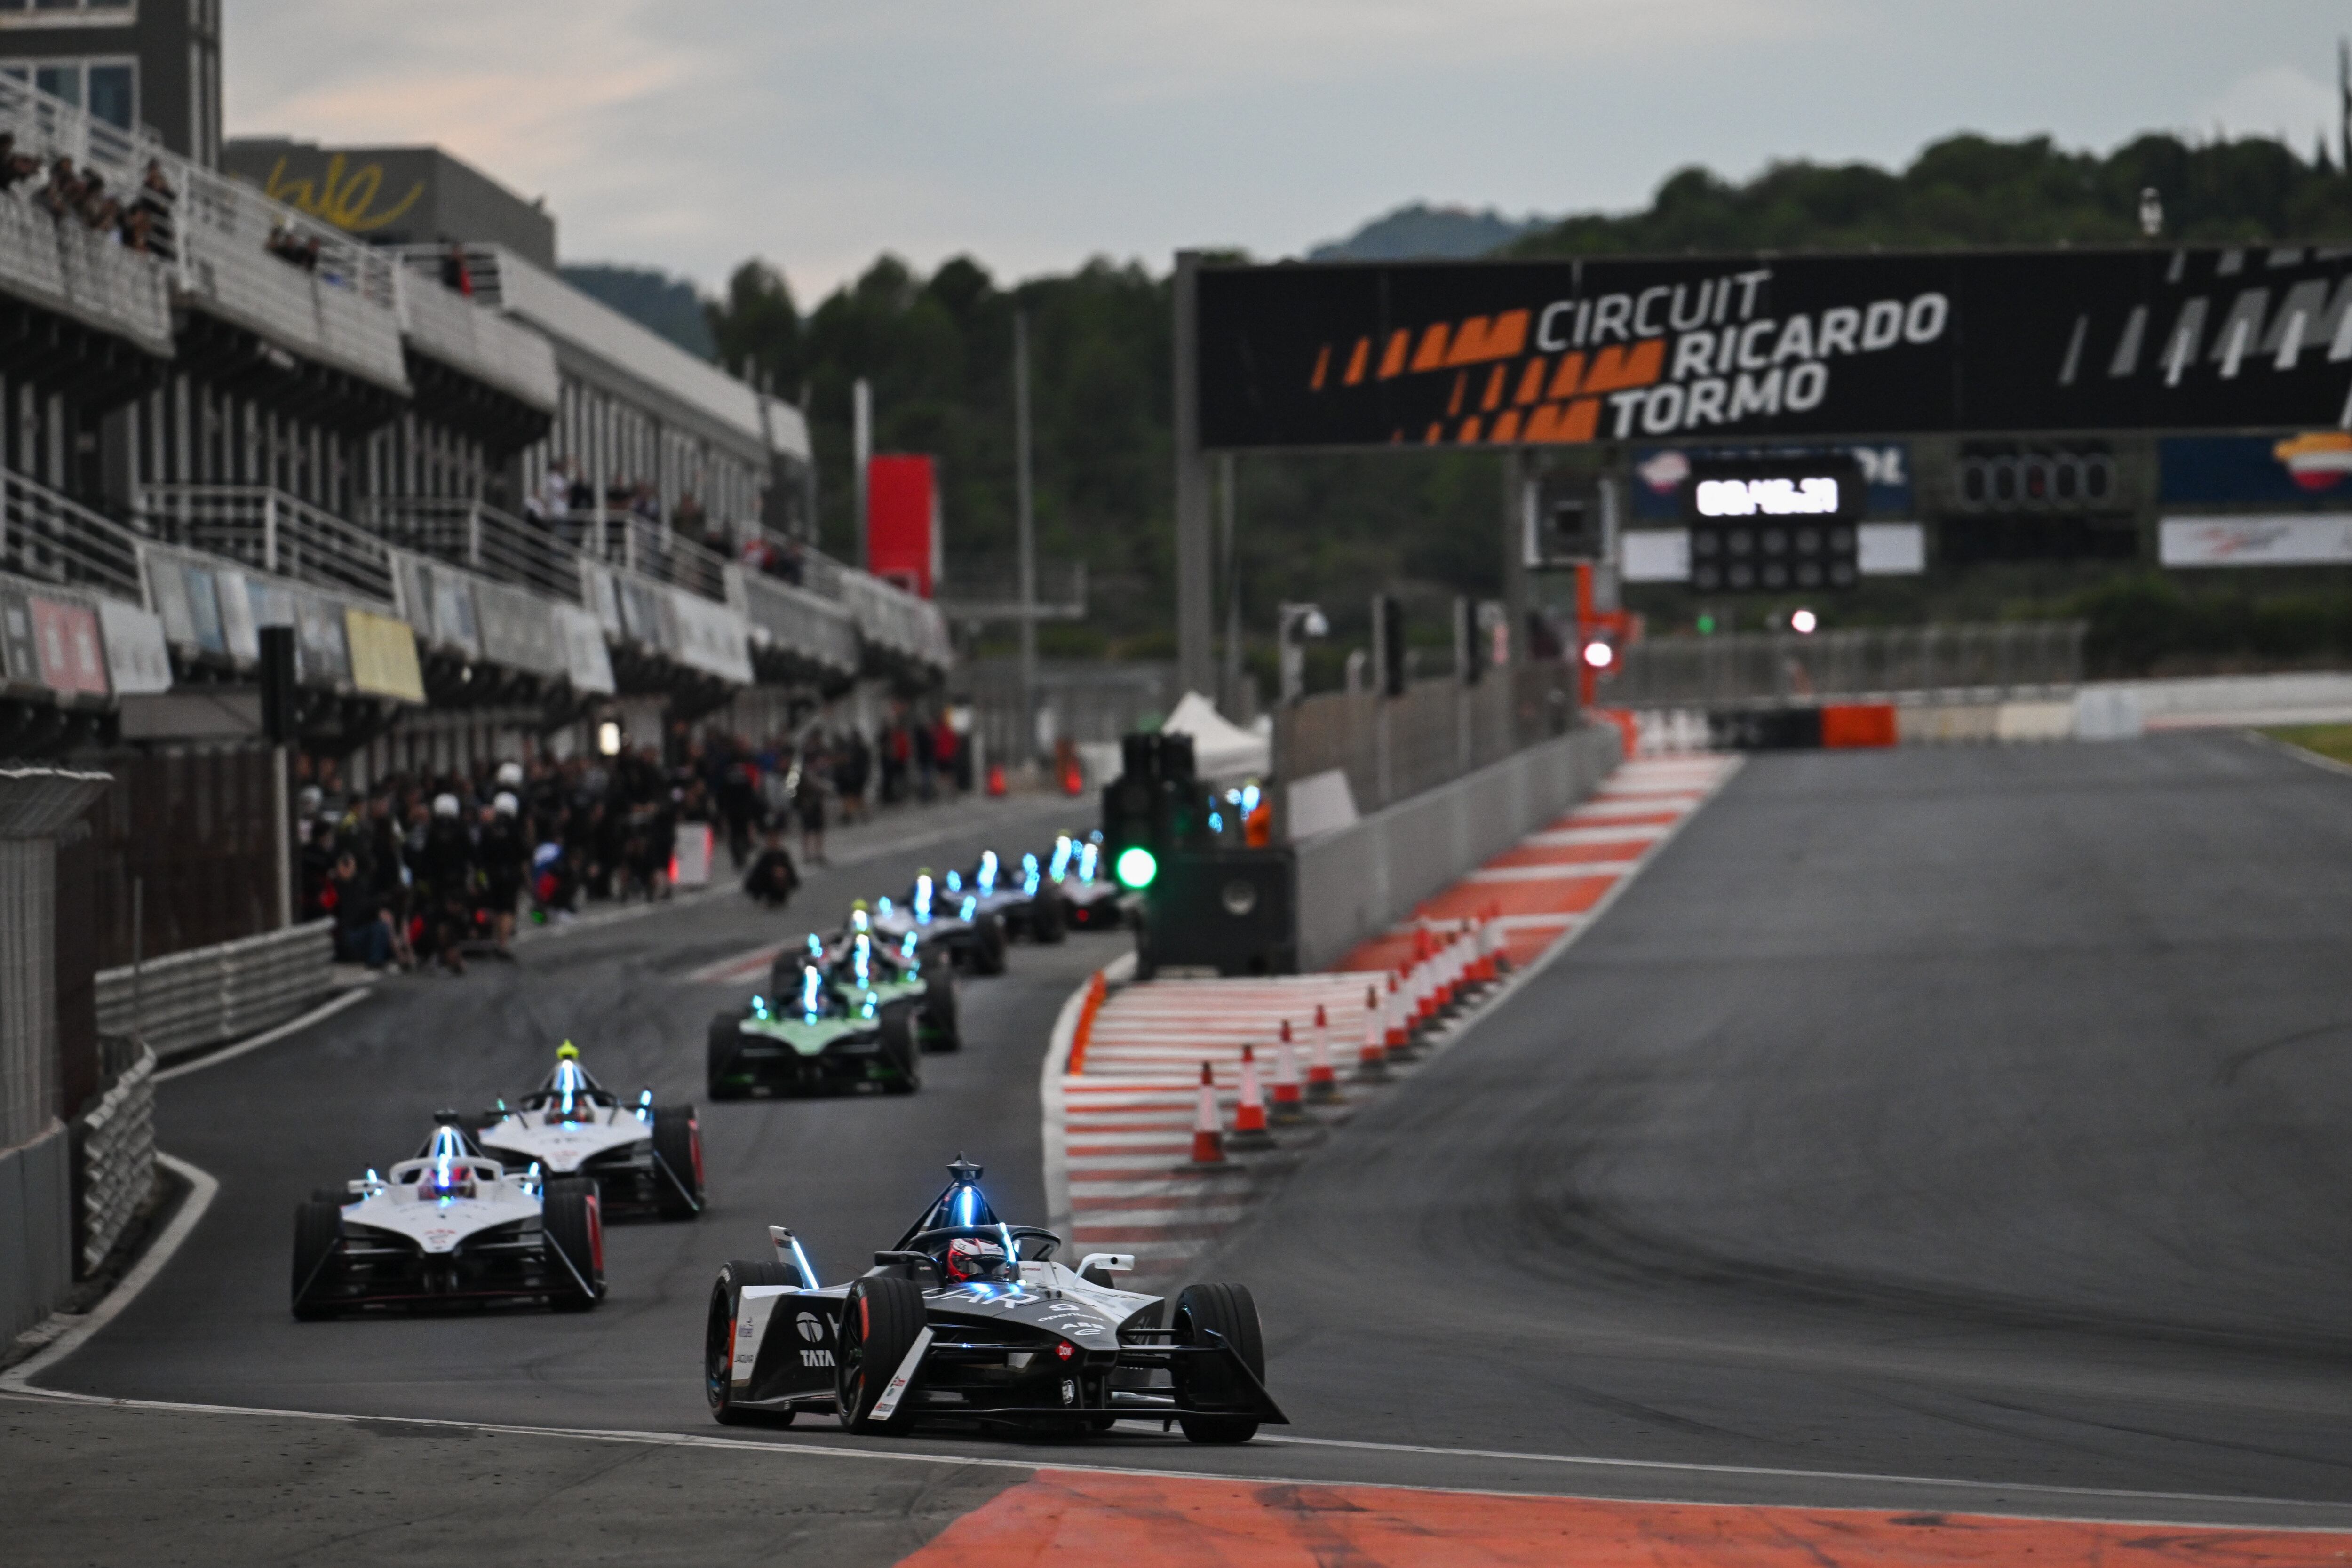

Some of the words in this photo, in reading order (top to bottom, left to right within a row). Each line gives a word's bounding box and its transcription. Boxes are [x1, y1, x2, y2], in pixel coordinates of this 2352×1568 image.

[1536, 269, 1772, 352] CIRCUIT
[1671, 291, 1949, 382] RICARDO
[1607, 361, 1828, 441] TORMO
[799, 1349, 836, 1367] TATA
